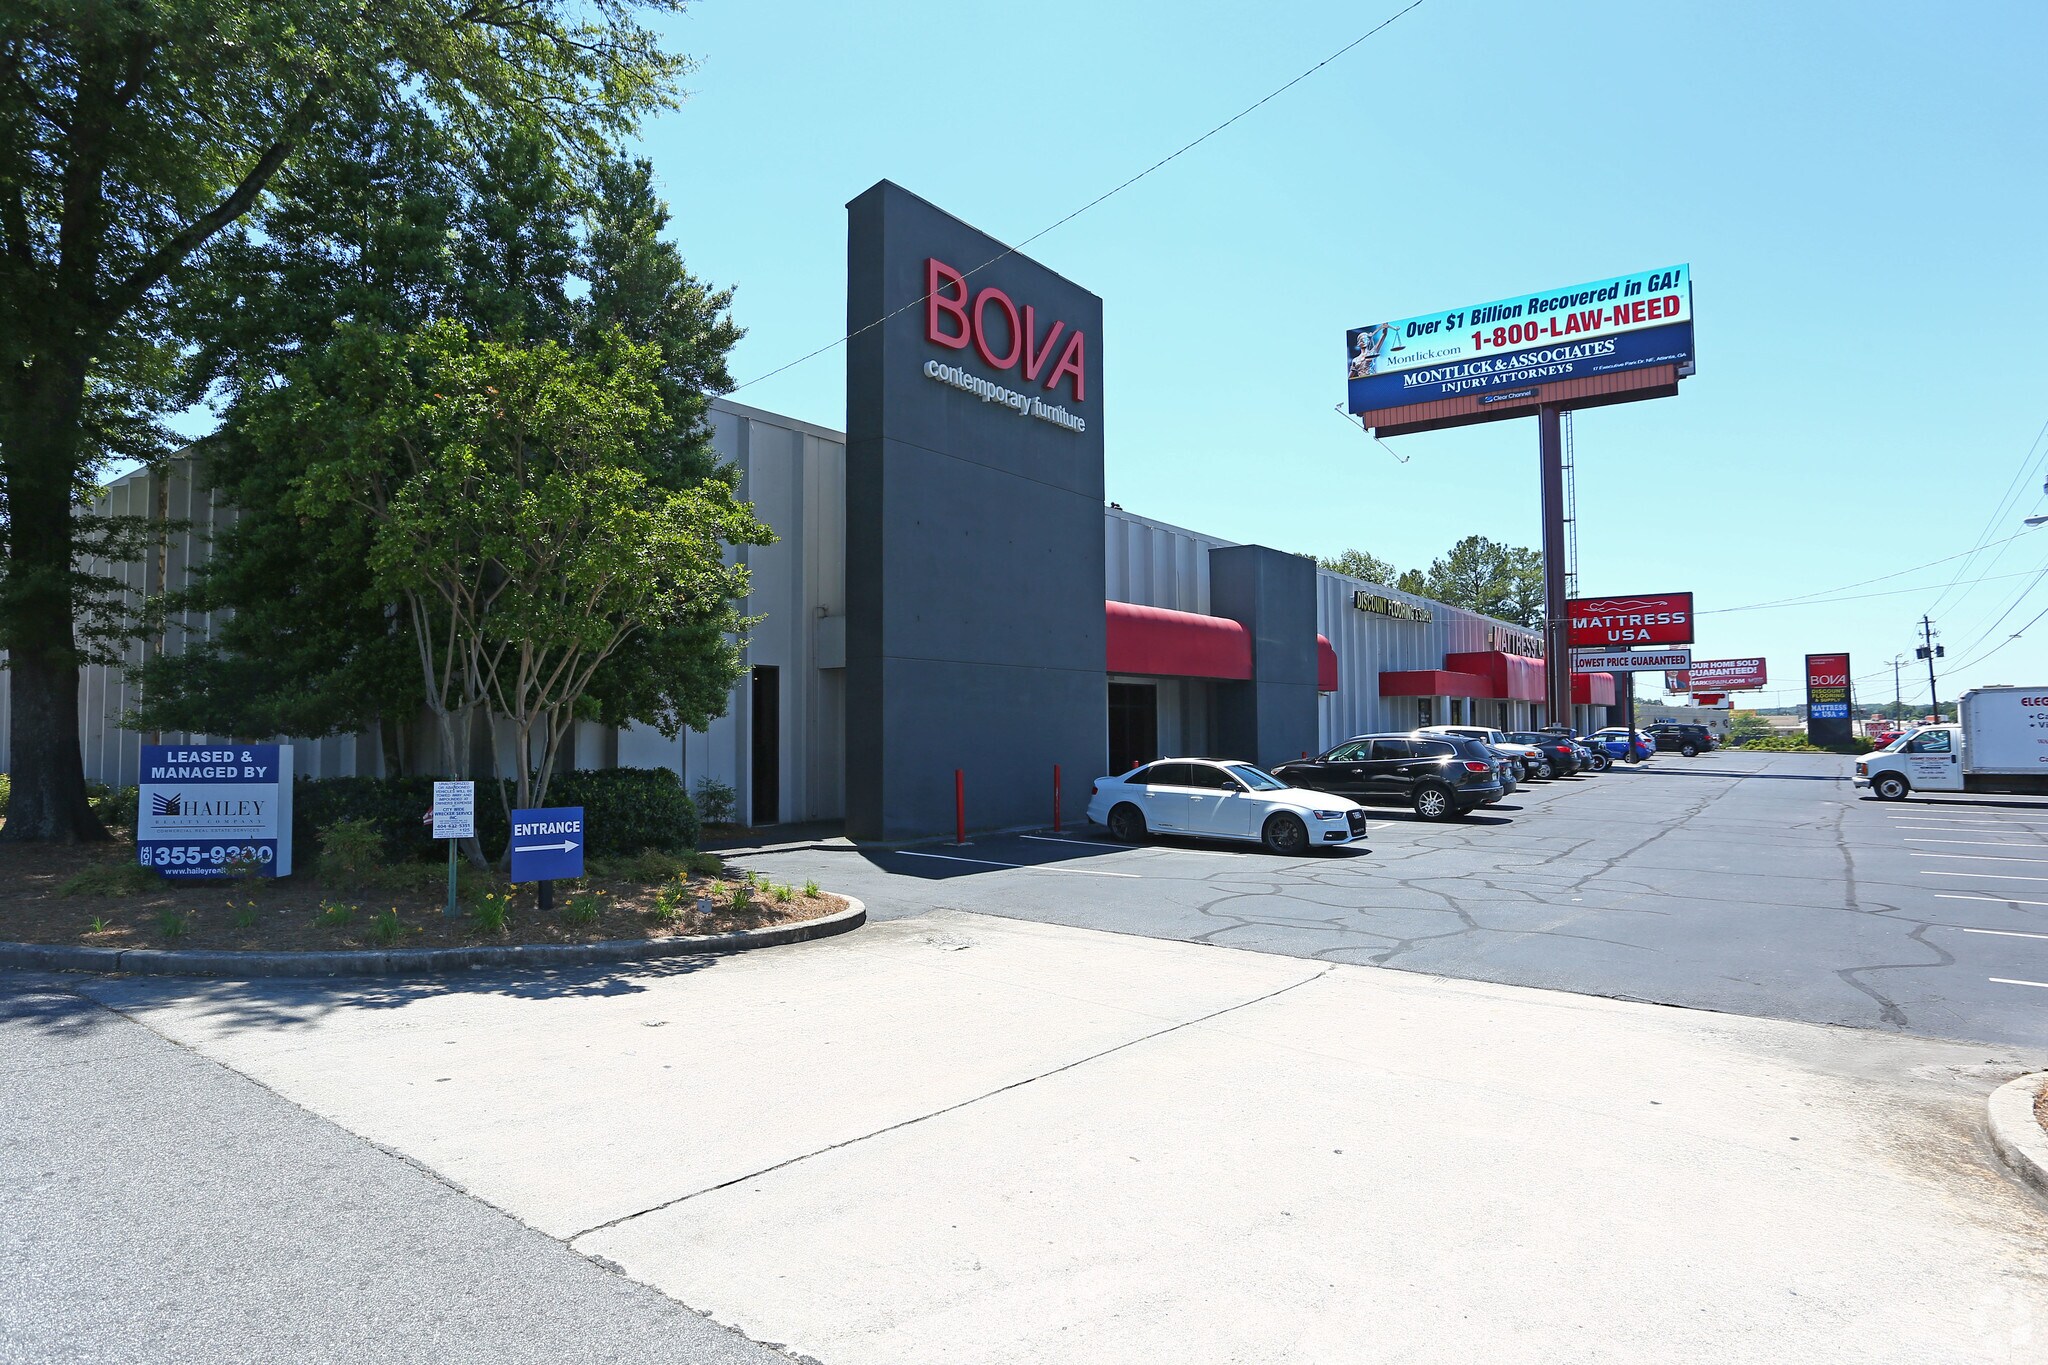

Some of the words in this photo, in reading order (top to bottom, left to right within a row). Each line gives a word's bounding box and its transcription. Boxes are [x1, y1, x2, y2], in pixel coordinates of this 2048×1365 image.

[1406, 319, 1441, 338] Over
[1445, 312, 1464, 332] $1
[1470, 304, 1523, 326] Billion
[1527, 281, 1619, 315] Recovered
[1624, 279, 1642, 297] in
[1647, 269, 1681, 292] GA!
[925, 257, 1085, 402] BOVA
[1471, 294, 1681, 350] 1-800-LAW-NEED
[1386, 346, 1461, 366] Montlick.com
[1403, 360, 1492, 387] MONTLICK
[1441, 376, 1488, 393] INJURY
[1492, 362, 1574, 384] ATTORNEYS
[924, 360, 1031, 416] contemporary
[1031, 397, 1086, 432] furniture
[1508, 390, 1531, 399] Channel
[1355, 591, 1388, 614] DISCOUNT
[1573, 612, 1686, 629] MATTRESS
[1493, 626, 1536, 658] MATTRESS
[1608, 628, 1651, 641] USA
[1576, 658, 1605, 668] LOWEST
[1607, 657, 1629, 667] PRICE
[1631, 655, 1686, 666] GUARANTEED
[1688, 667, 1757, 677] GUARANTEED!
[1810, 675, 1846, 685] BOVA
[167, 751, 235, 763] LEASED
[240, 751, 253, 763] &
[151, 766, 238, 779] MANAGED
[244, 766, 268, 778] BY
[184, 800, 265, 816] HAILEY
[514, 821, 581, 836] ENTRANCE
